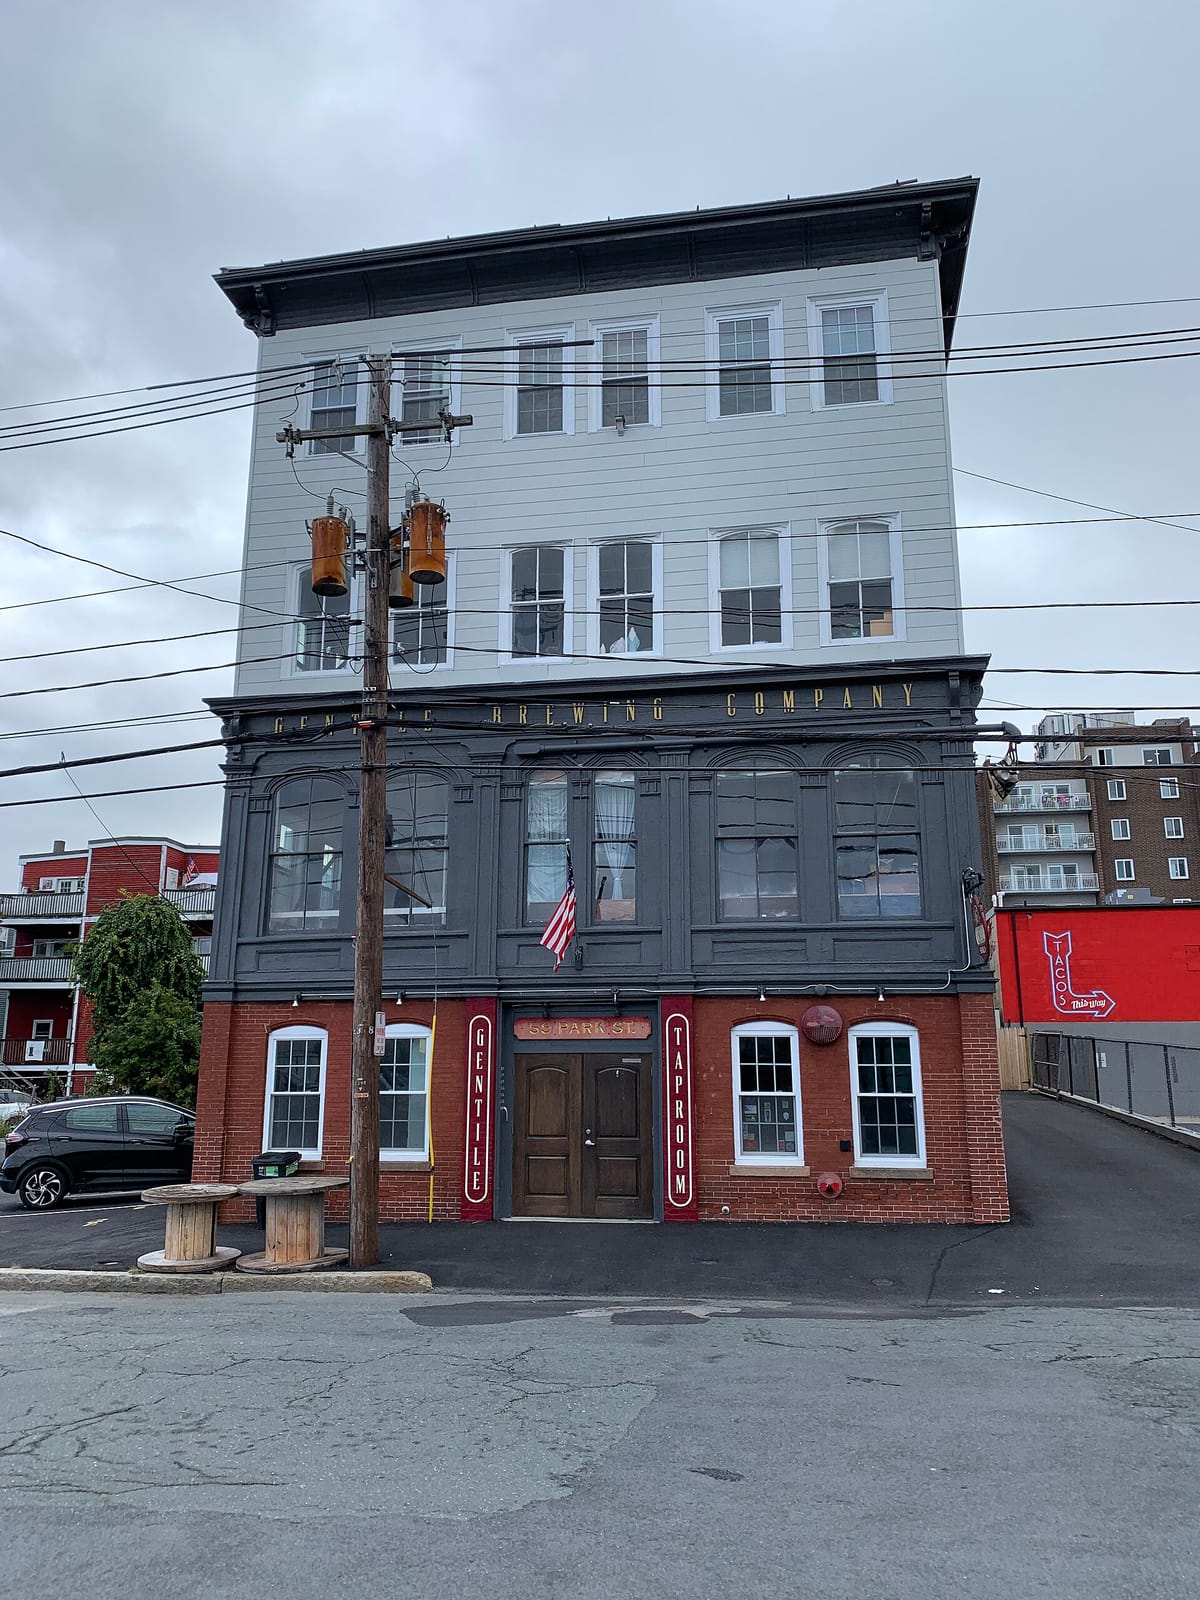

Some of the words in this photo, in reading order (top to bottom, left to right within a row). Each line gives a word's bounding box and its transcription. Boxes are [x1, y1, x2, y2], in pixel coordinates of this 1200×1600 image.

[274, 709, 432, 736] GENTLE
[492, 697, 663, 726] BREWING
[726, 683, 913, 717] COMPANY
[1053, 941, 1067, 1006] TACOS
[558, 1021, 606, 1035] PARK
[612, 1020, 636, 1035] ST.
[473, 1028, 485, 1191] GENTILE
[674, 1027, 686, 1194] TAPROOM
